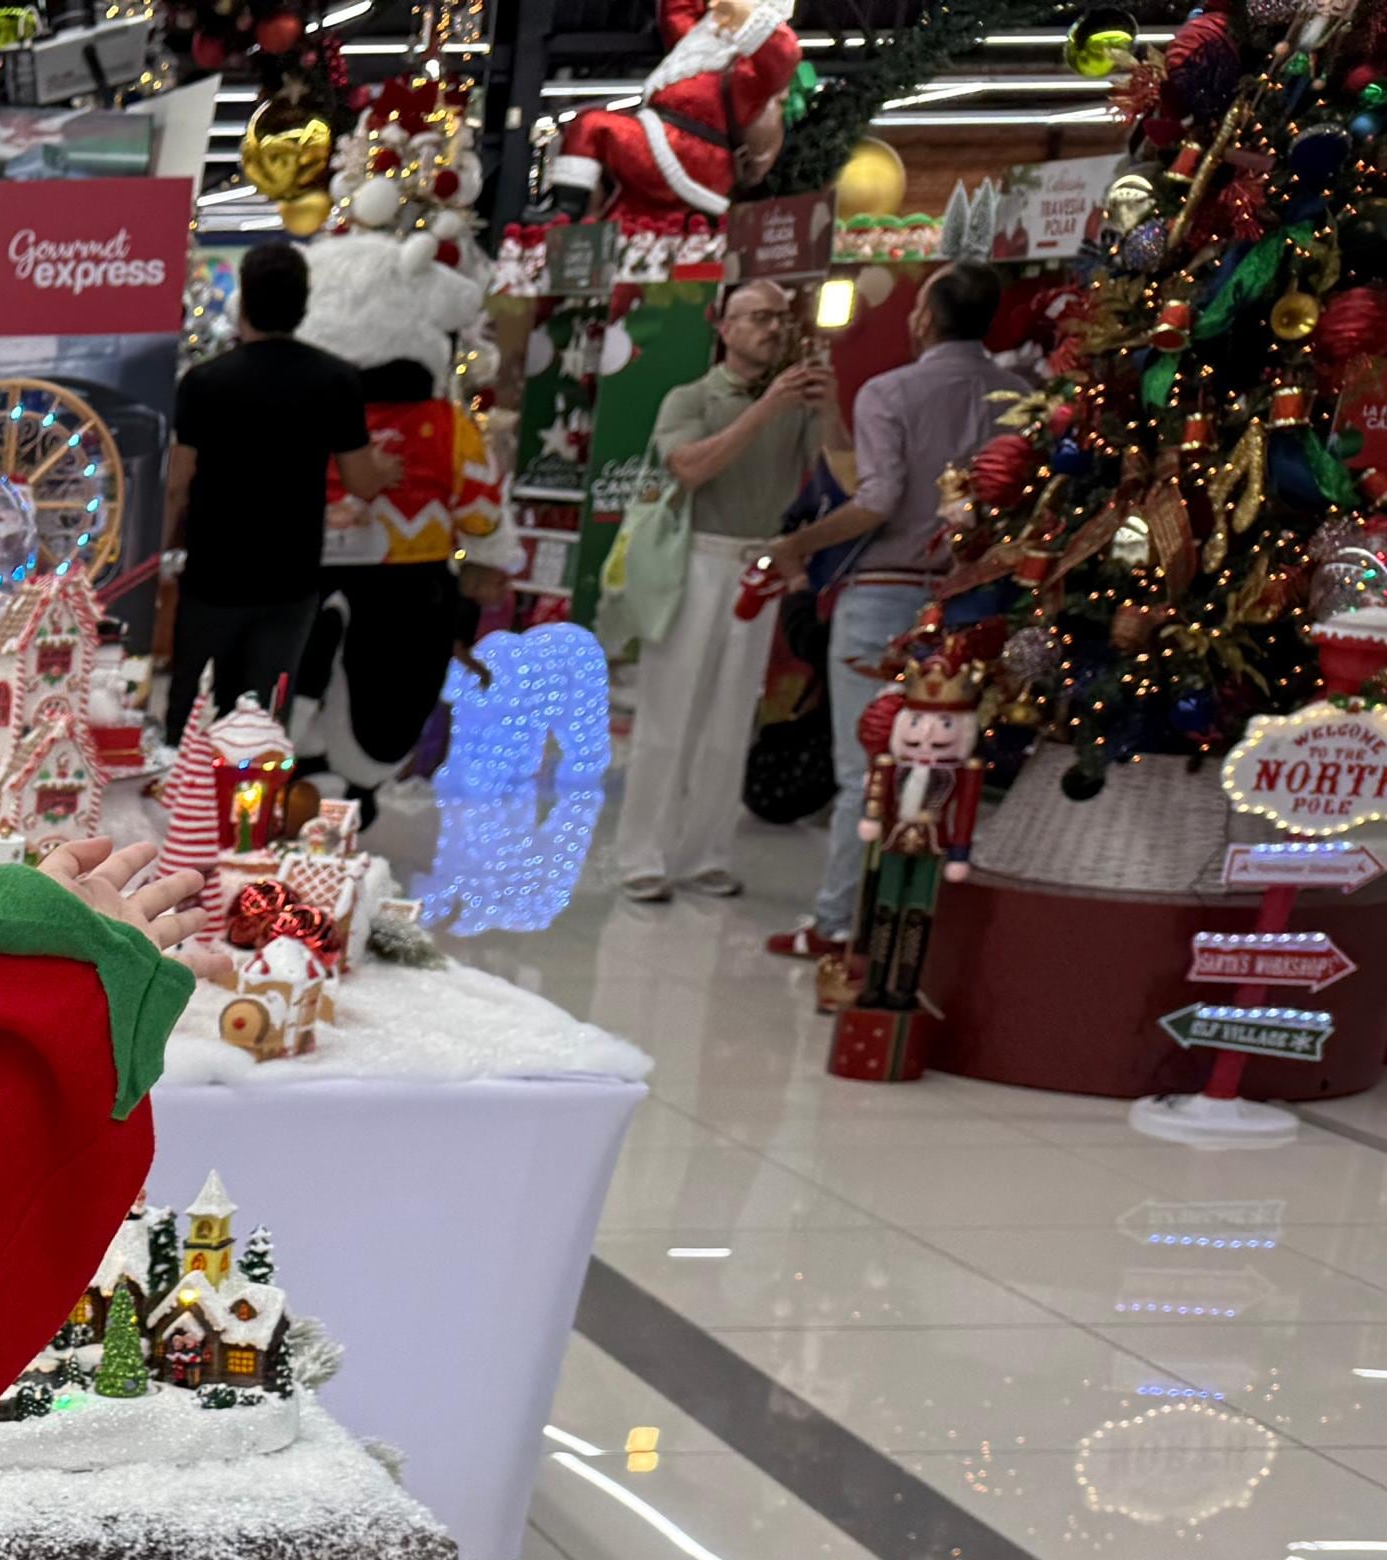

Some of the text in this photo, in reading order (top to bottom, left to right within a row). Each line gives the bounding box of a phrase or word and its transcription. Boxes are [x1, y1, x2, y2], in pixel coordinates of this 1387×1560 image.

[8, 227, 131, 280] Gourmet
[33, 258, 166, 296] express
[1293, 723, 1387, 755] WELCOME
[1309, 747, 1367, 761] TO THE
[1291, 797, 1353, 816] POLE
[1223, 1024, 1291, 1048] VILLAGE
